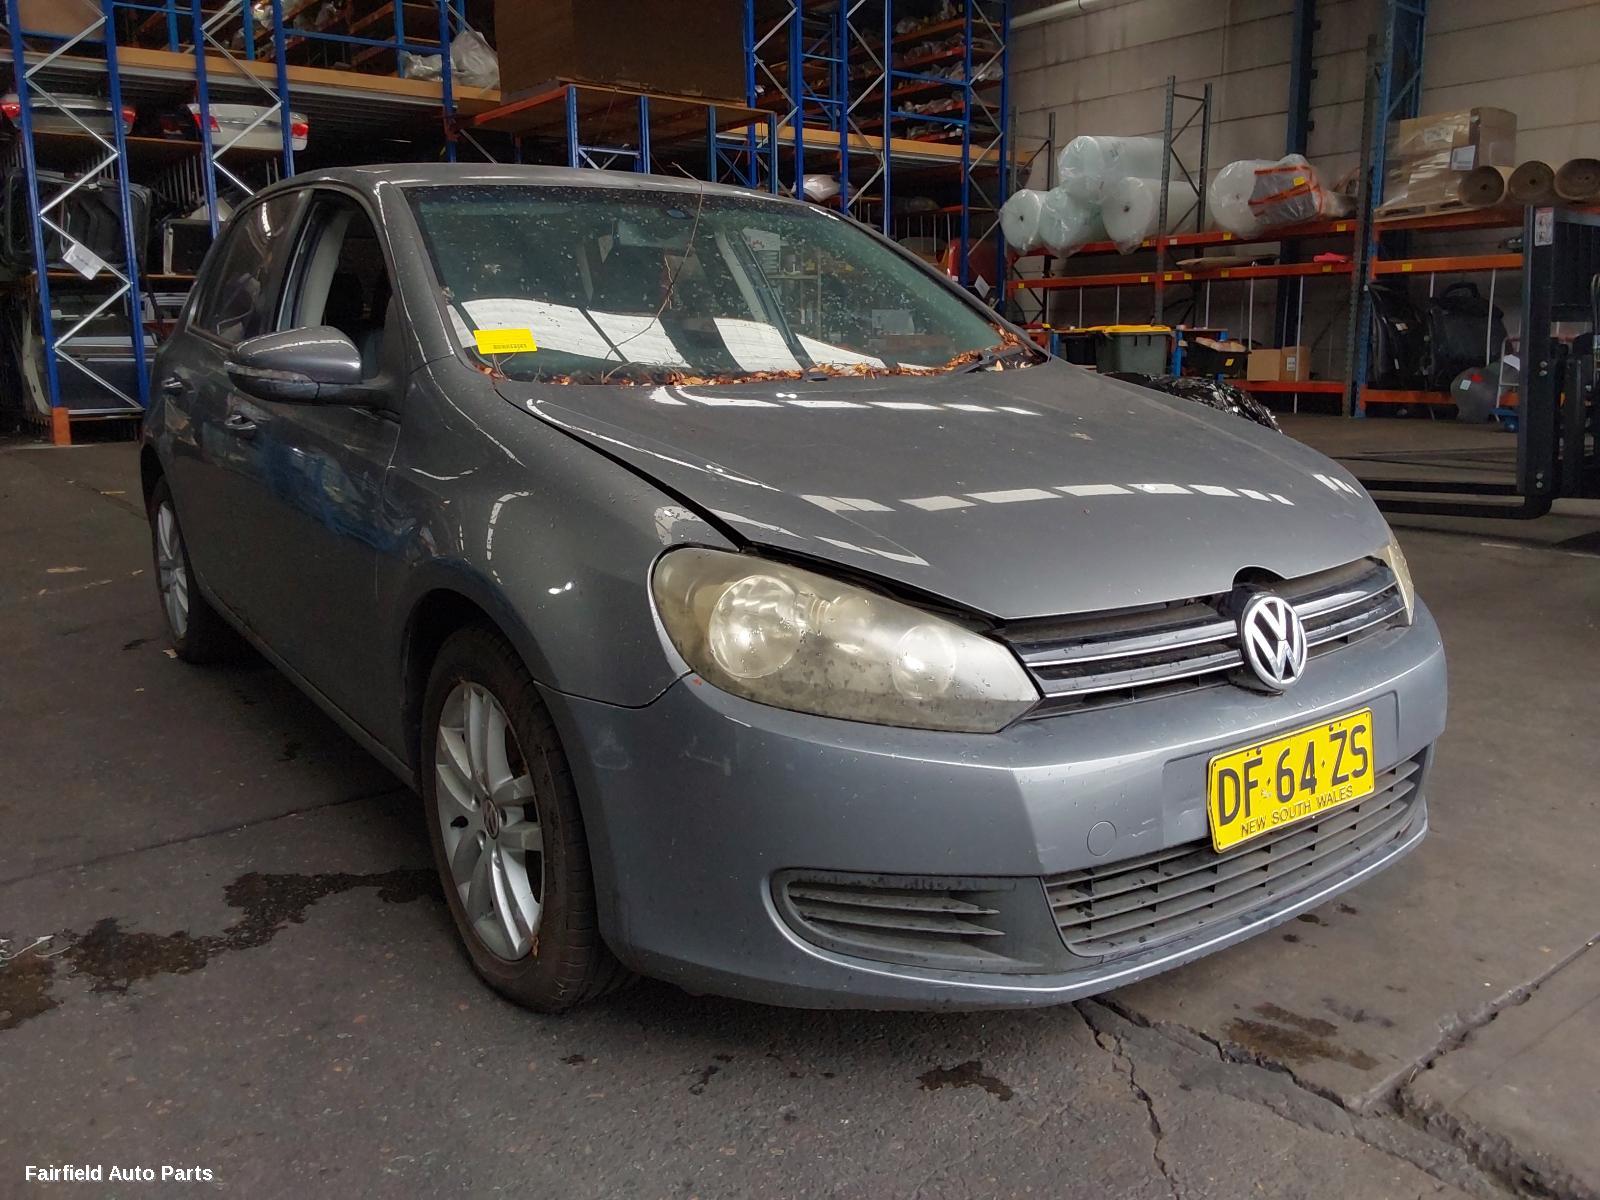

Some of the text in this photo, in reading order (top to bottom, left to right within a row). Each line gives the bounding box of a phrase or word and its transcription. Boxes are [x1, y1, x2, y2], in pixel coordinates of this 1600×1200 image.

[1240, 785, 1354, 838] NEW SOUTH WALES
